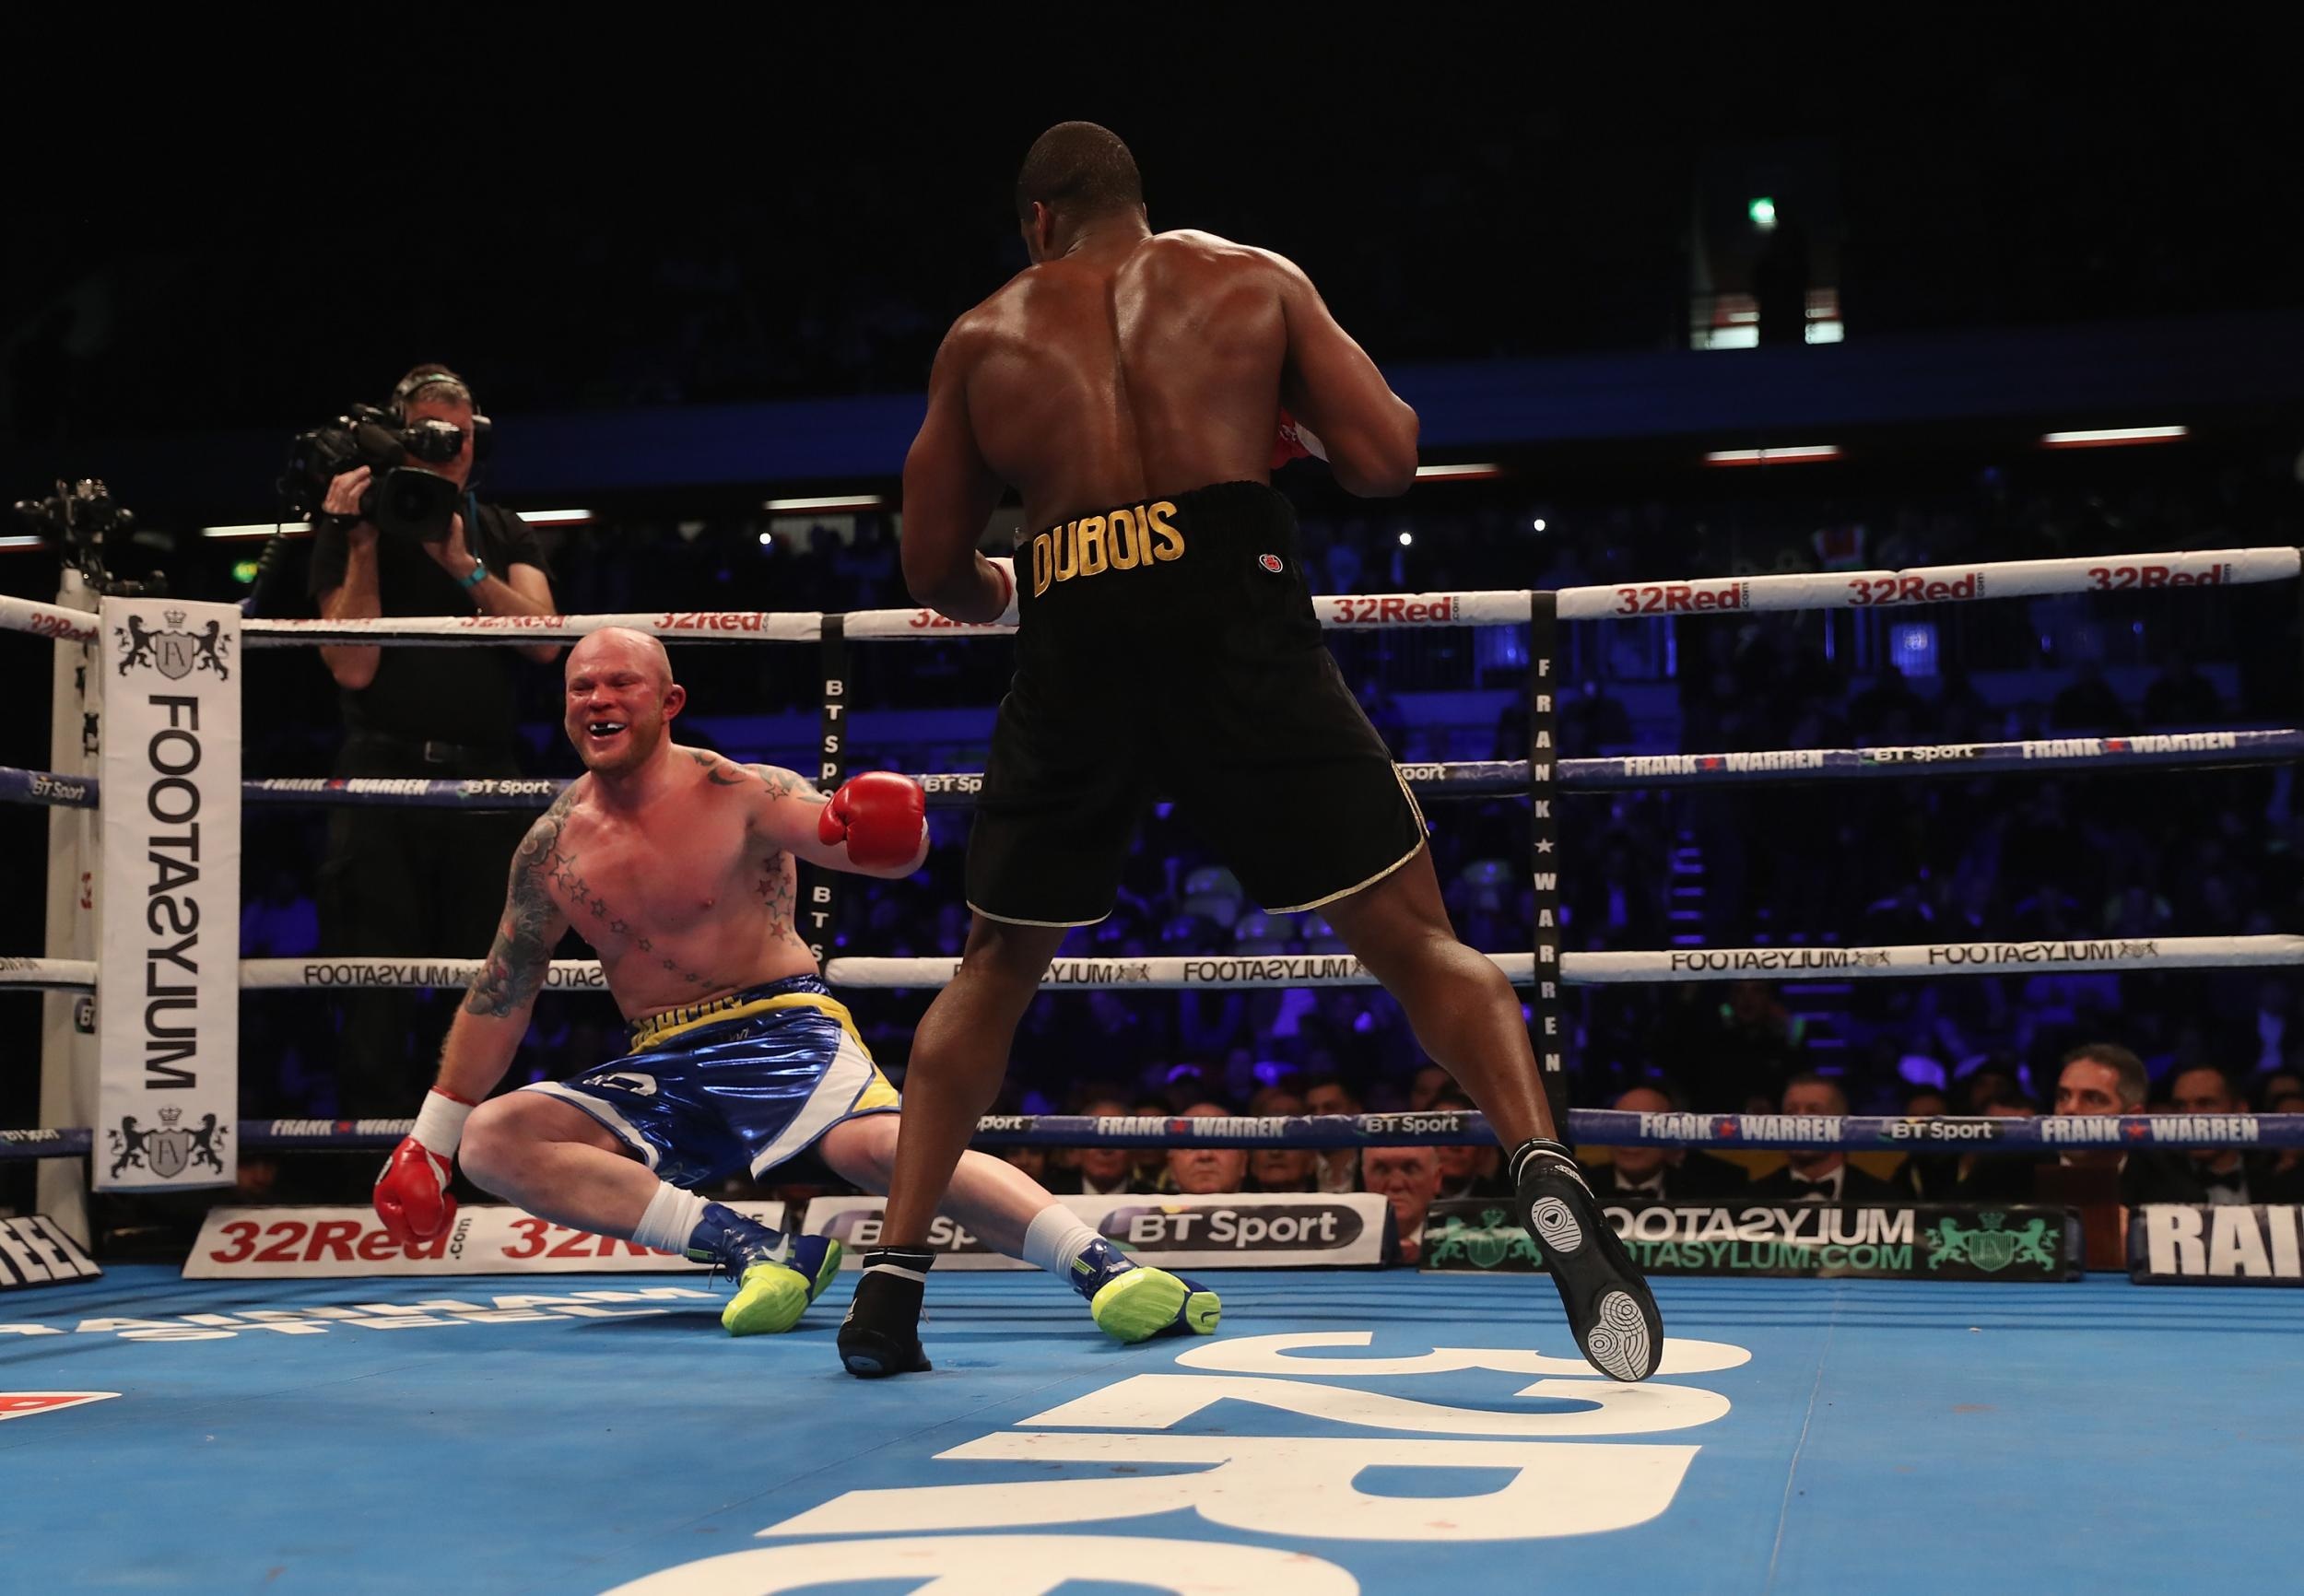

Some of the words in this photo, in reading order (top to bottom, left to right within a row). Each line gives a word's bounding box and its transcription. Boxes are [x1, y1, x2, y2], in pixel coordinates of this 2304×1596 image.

[1032, 500, 1185, 599] DUBOIS
[1616, 582, 1740, 615] 32Red
[1848, 573, 1975, 605] 32Red
[1333, 596, 1452, 624] 32Red
[825, 680, 843, 721] BT
[1534, 659, 1552, 819] FRANK
[2023, 737, 2102, 759] FRANK
[2130, 732, 2236, 754] WARREN
[1625, 757, 1698, 777] FRANK
[1726, 749, 1824, 772] WARREN
[1874, 746, 1905, 761] BT
[1911, 744, 1974, 761] Sport
[346, 779, 431, 795] WARREN
[466, 780, 499, 793] BT
[500, 780, 550, 797] Sport
[923, 778, 956, 792] BT
[145, 695, 202, 1089] FOOTASYLUM
[811, 886, 831, 929] BT
[1671, 951, 1847, 972] FOOTASYLUM
[1930, 943, 2112, 965] FOOTASYLUM
[305, 965, 449, 986] FOOTASYLUM
[1184, 959, 1346, 982] FOOTASYLUM
[1534, 873, 1561, 1073] WARREN
[271, 1120, 334, 1136] FRANK
[1098, 1116, 1166, 1136] FRANK
[1193, 1116, 1286, 1138] WARREN
[1366, 1118, 1399, 1133] BT
[1401, 1116, 1458, 1135] Sport
[1640, 1116, 1713, 1140] FRANK
[1740, 1118, 1840, 1142] WARREN
[1891, 1122, 1925, 1139] BT
[1931, 1121, 1992, 1141] Sport
[2041, 1118, 2120, 1143] FRANK
[2150, 1117, 2259, 1143] WARREN
[1129, 1215, 1203, 1243] BT
[1208, 1210, 1337, 1249] Sport
